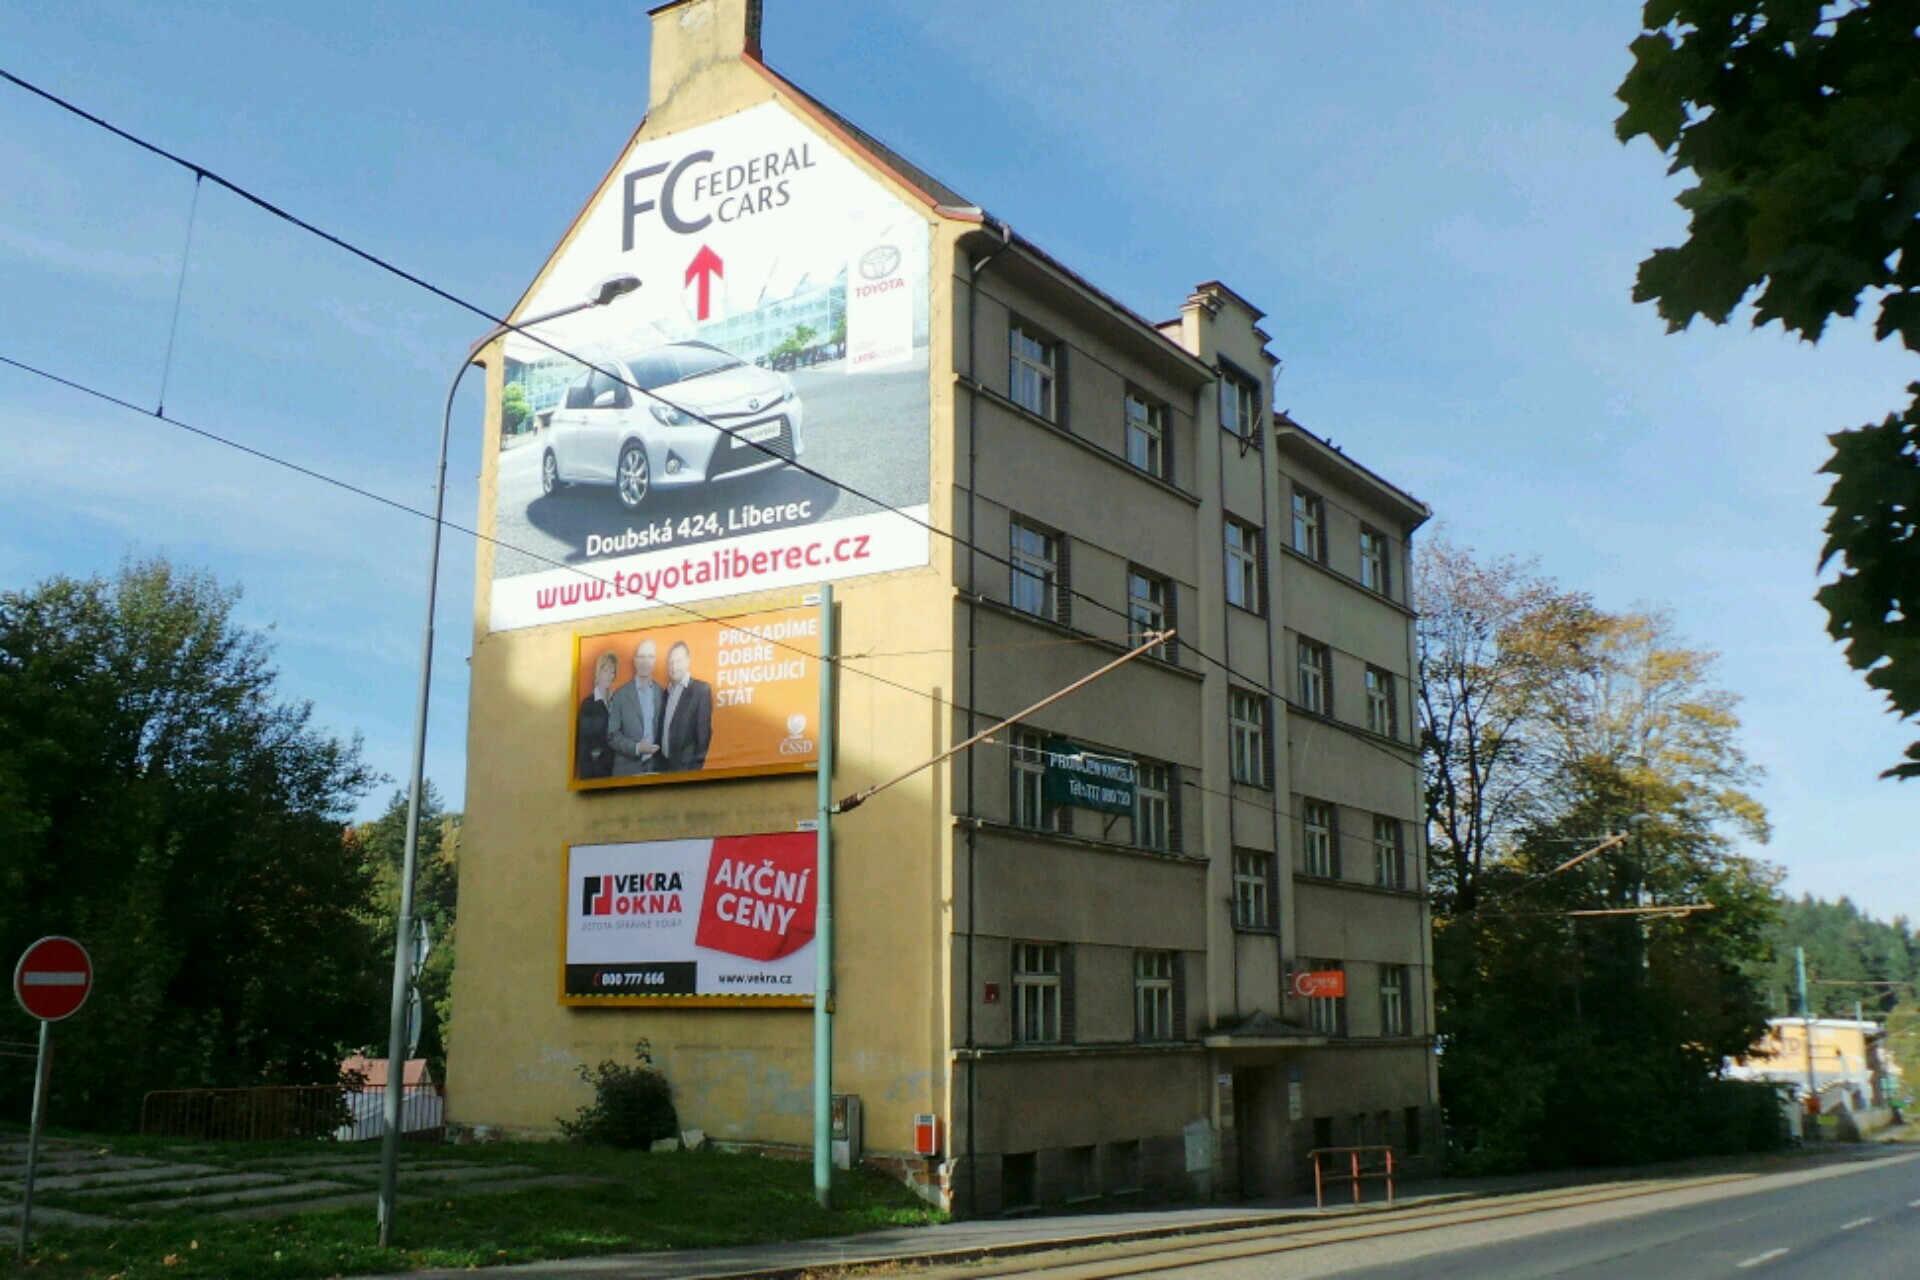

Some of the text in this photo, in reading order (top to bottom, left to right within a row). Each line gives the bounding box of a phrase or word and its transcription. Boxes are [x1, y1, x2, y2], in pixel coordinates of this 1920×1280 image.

[694, 143, 816, 201] FEDERAL
[717, 180, 791, 223] CARS
[854, 278, 906, 299] TOYOTA
[586, 500, 812, 557] Doubská 424, Liberec
[536, 534, 871, 610] www.toyotaliberec.cz
[718, 618, 818, 647] PROSADÍME
[717, 644, 774, 667] DOBŘE
[716, 658, 806, 689] FUNGUJÍCÍ
[715, 687, 755, 708] STÁT
[779, 736, 813, 756] ČSSD
[614, 872, 682, 893] VEKRA
[714, 858, 811, 904] AKČNÍ
[615, 894, 682, 915] OKNA
[716, 892, 797, 936] CENY
[623, 971, 643, 986] 777
[718, 971, 793, 986] www.vekra.cz
